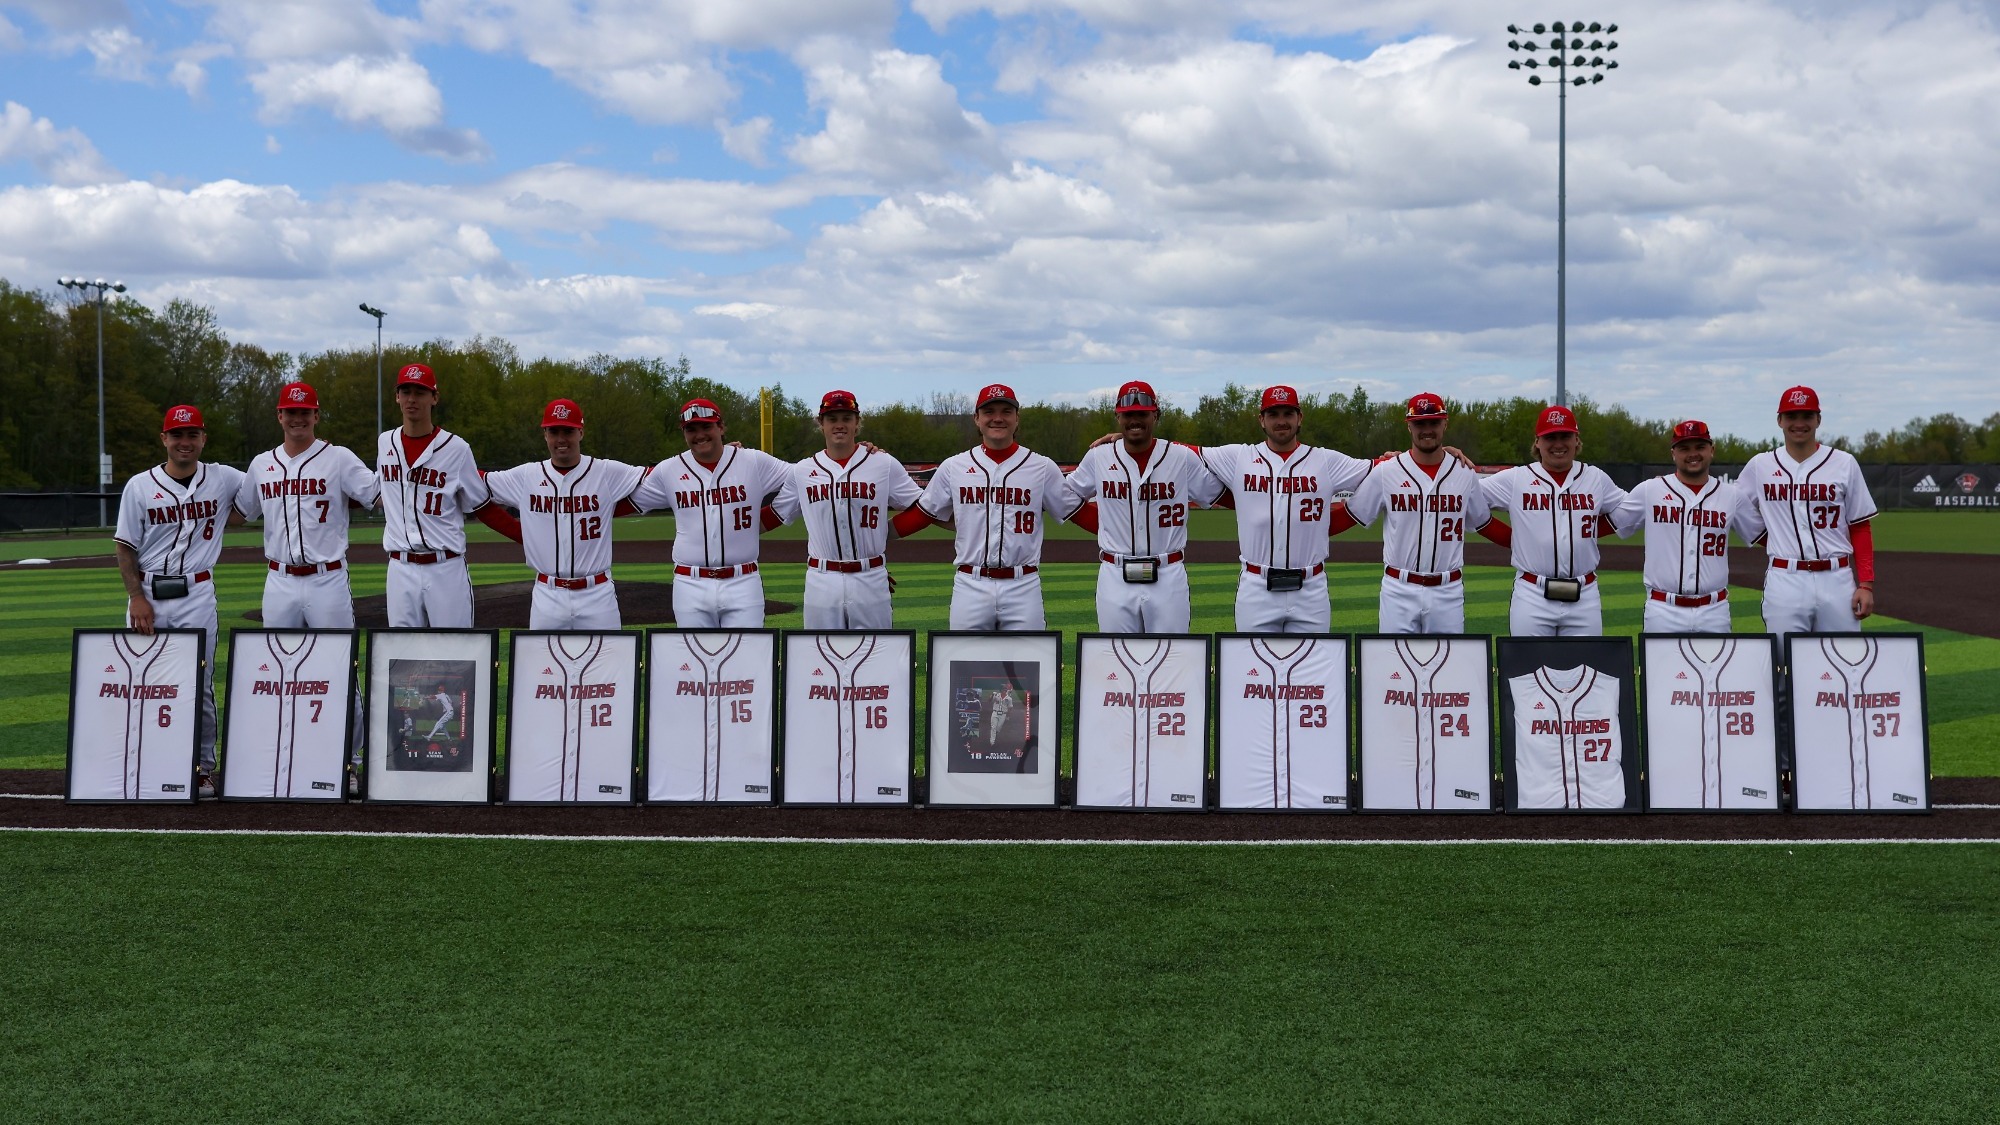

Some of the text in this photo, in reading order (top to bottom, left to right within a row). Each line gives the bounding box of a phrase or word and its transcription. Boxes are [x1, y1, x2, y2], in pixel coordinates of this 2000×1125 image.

[260, 478, 326, 500] PANTHERS
[806, 482, 876, 505] PANTHERS
[1243, 474, 1318, 494] PANTHERS
[1763, 483, 1836, 502] PANTHERS
[1913, 485, 1940, 493] adidas
[423, 492, 442, 516] 11
[530, 494, 599, 513] PANTHERS
[675, 485, 746, 509] PANTHERS
[960, 486, 1031, 506] PANTHERS
[1935, 496, 2000, 506] BASEBALL
[148, 499, 218, 526] PANTHERS
[316, 500, 329, 523] 7
[733, 506, 752, 531] 15
[860, 505, 879, 529] 16
[1158, 504, 1185, 528] 22
[1299, 498, 1324, 522] 23
[1813, 506, 1841, 529] 37
[202, 519, 214, 541] 6
[579, 516, 601, 541] 12
[1013, 511, 1034, 534] 18
[1440, 518, 1463, 542] 24
[1702, 533, 1726, 557] 28
[99, 683, 179, 700] PANTHERS
[252, 680, 329, 696] PANTHERS
[535, 682, 616, 700] PANTHERS
[676, 679, 754, 697] PANTHERS
[809, 685, 889, 701] PANTHERS
[1243, 684, 1325, 700] PANTHERS
[1384, 689, 1470, 708] PANTHERS
[1671, 690, 1756, 707] PANTHERS
[1103, 692, 1185, 708] PANTHERS
[1816, 691, 1901, 708] PANTHERS
[159, 705, 171, 727] 6
[310, 700, 322, 722] 7
[591, 704, 611, 726] 12
[731, 700, 751, 722] 15
[866, 706, 887, 728] 16
[1300, 705, 1327, 727] 23
[1158, 713, 1185, 735] 22
[1440, 714, 1469, 736] 24
[1531, 718, 1611, 736] PANTHERS
[1726, 712, 1754, 735] 28
[1872, 713, 1900, 736] 37
[1584, 739, 1611, 762] 27
